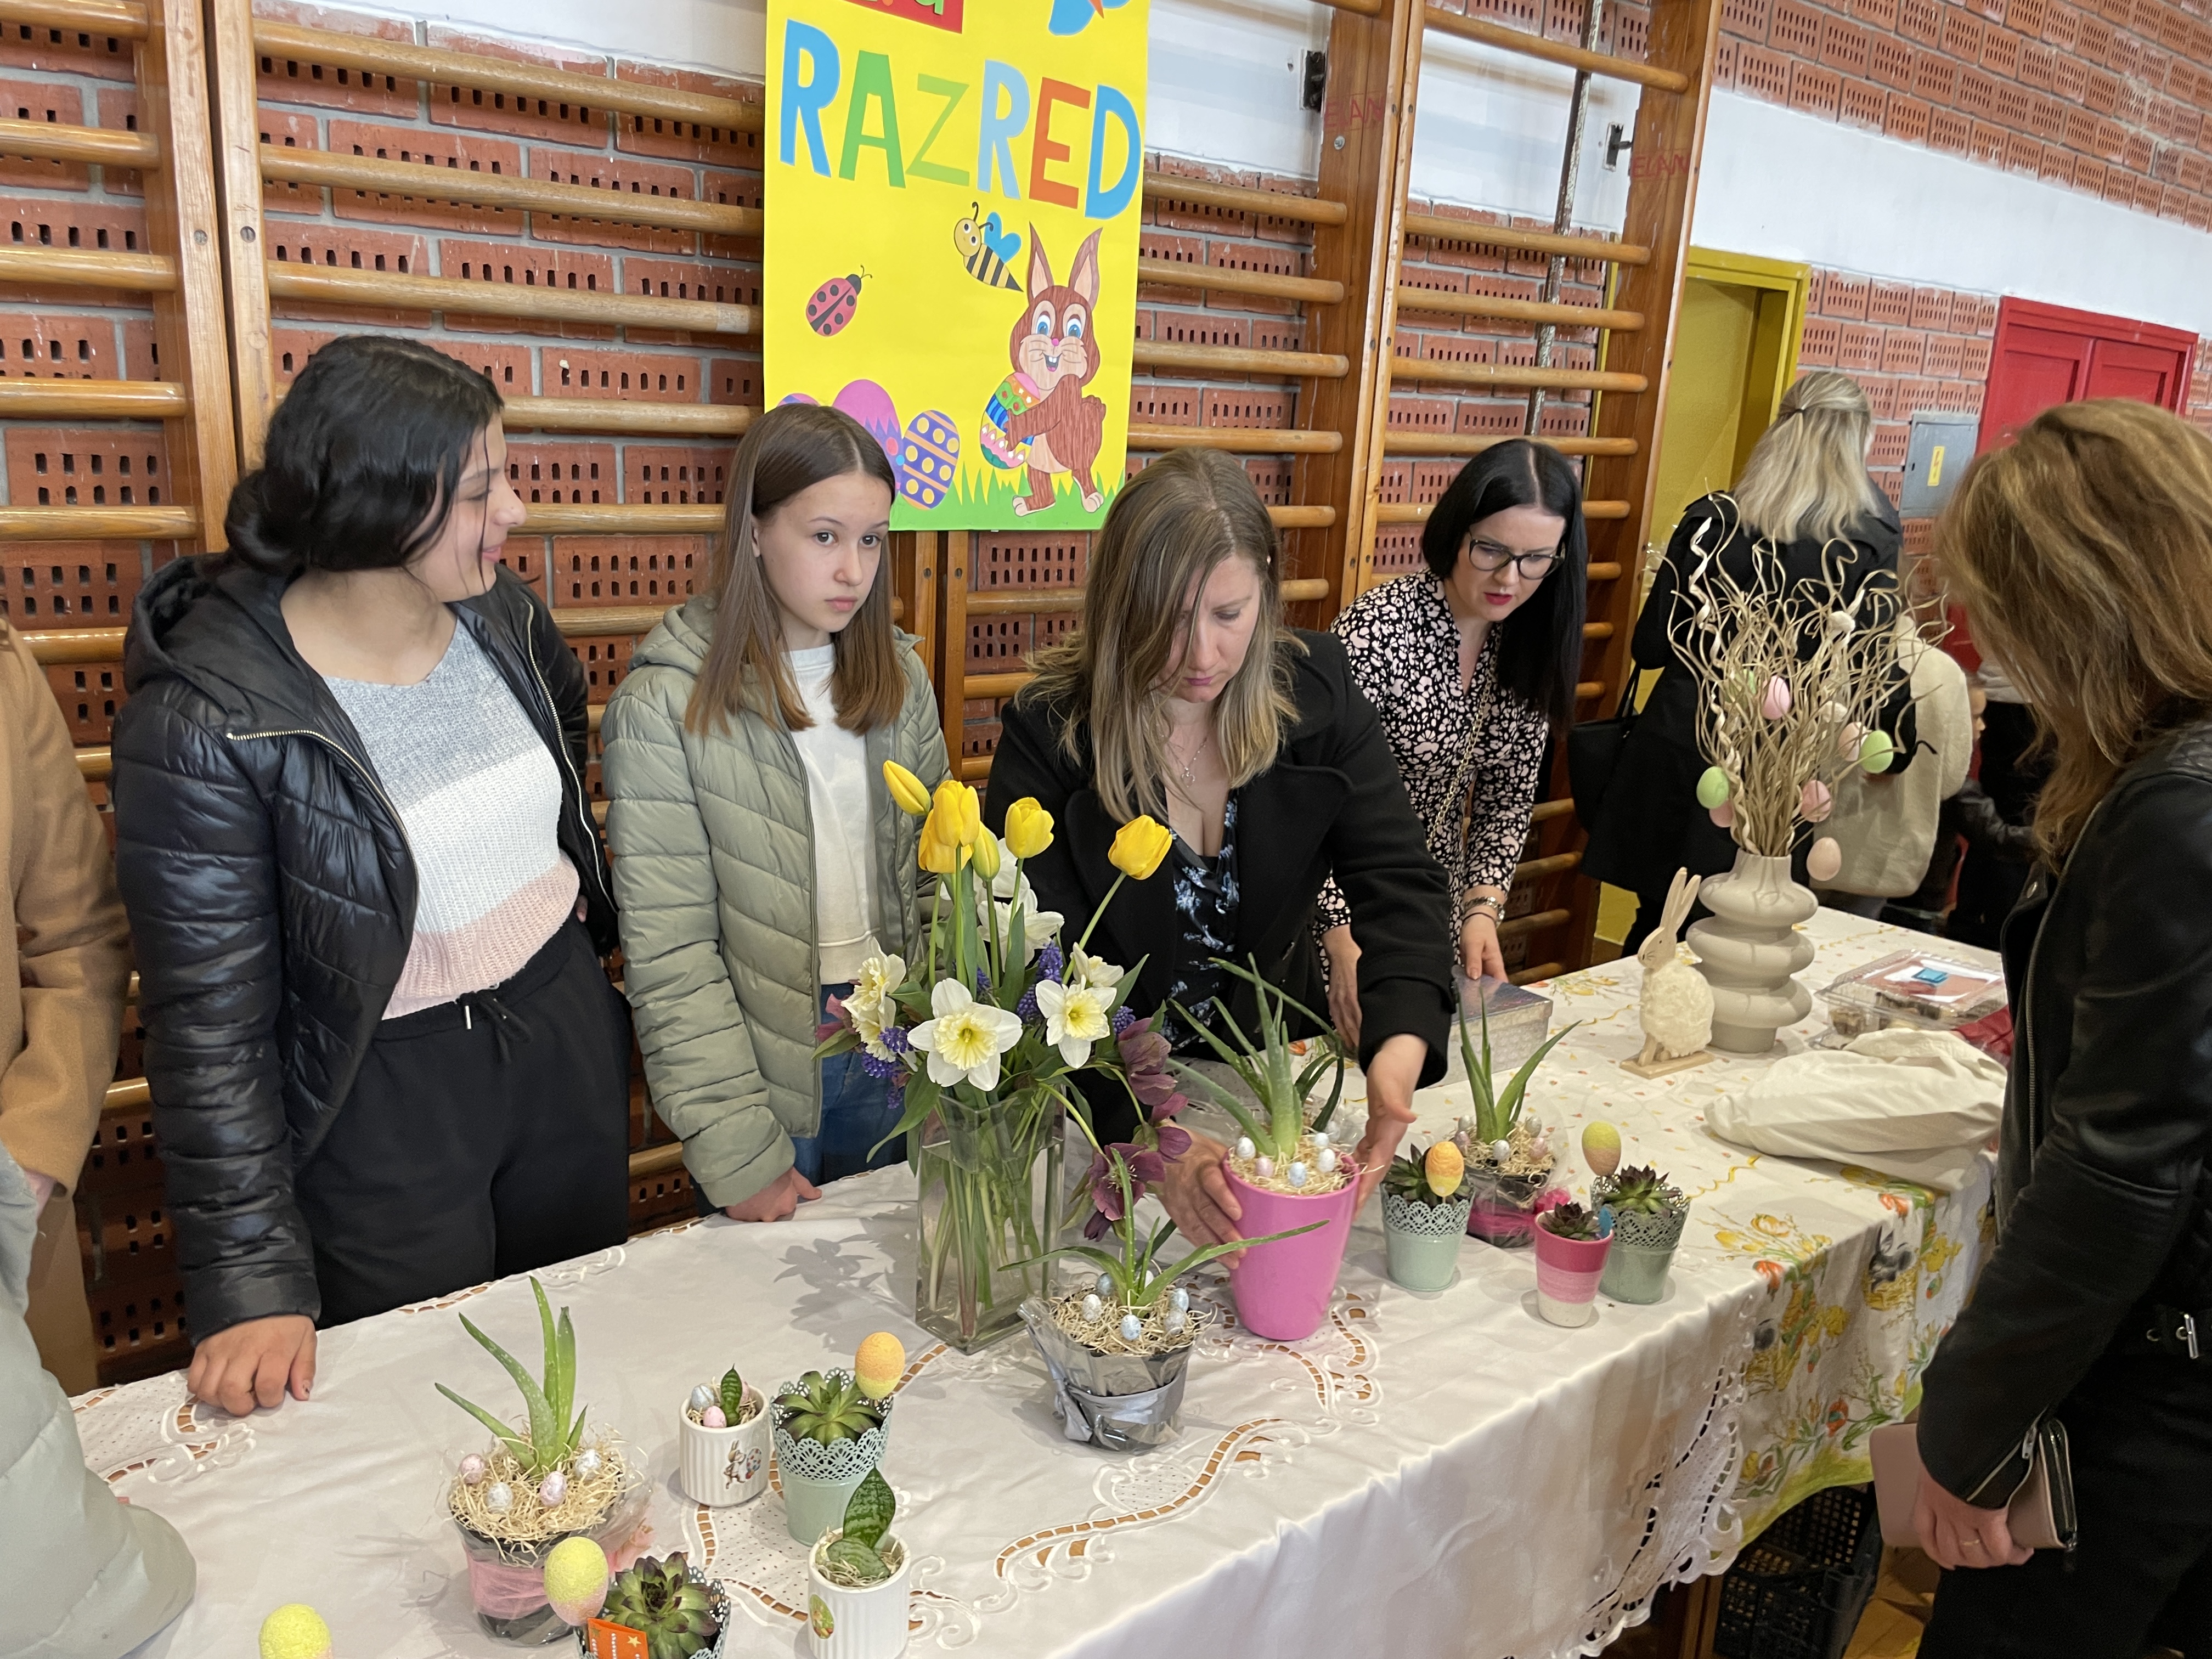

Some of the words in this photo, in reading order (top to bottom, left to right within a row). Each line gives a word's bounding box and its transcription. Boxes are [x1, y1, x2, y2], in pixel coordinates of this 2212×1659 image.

[780, 19, 1141, 219] RAZRED
[1324, 95, 1384, 128] ELAN
[1632, 153, 1690, 177] ELAN
